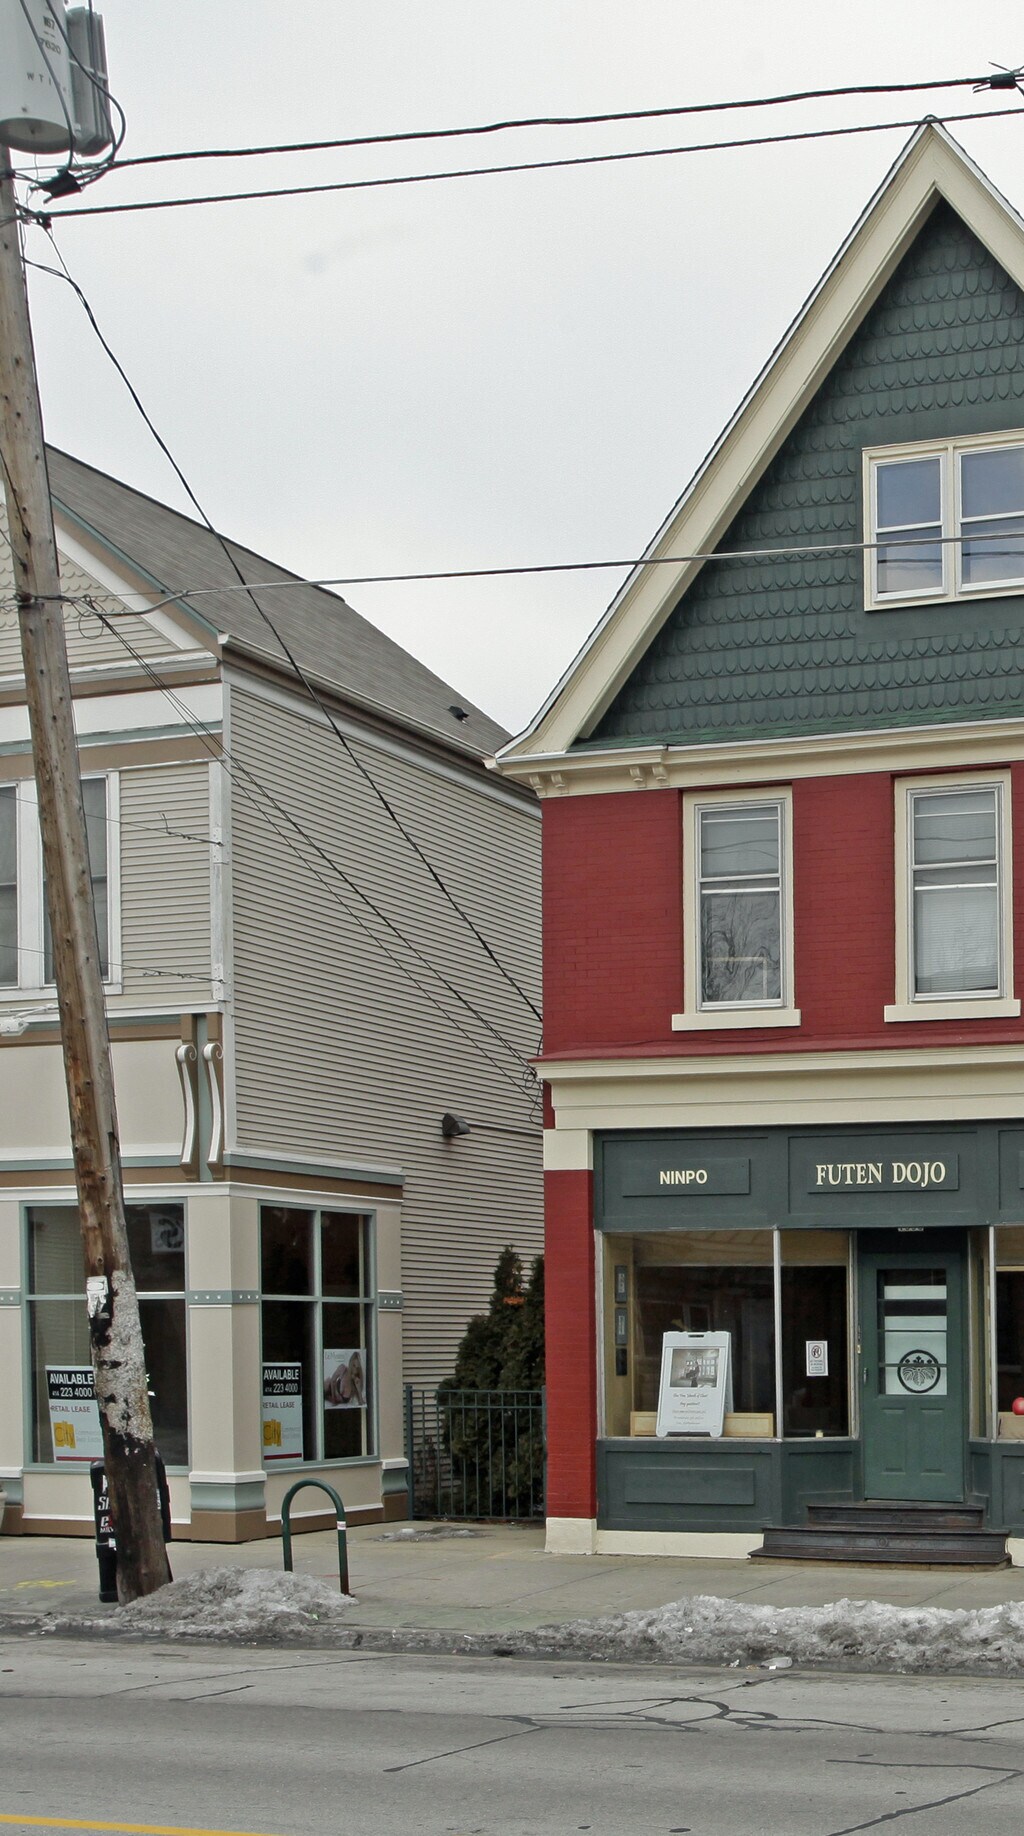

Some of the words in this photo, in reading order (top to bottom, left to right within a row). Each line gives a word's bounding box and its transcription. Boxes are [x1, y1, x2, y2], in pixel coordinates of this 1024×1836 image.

[659, 1169, 708, 1185] NINPO
[815, 1163, 883, 1186] FUTEN
[891, 1161, 946, 1187] DOJO
[49, 1373, 94, 1385] AVAILABLE
[264, 1369, 299, 1380] AVAILABLE
[61, 1387, 73, 1397] 223
[74, 1387, 93, 1398] 4000
[273, 1383, 284, 1393] 223
[285, 1383, 298, 1393] 4000
